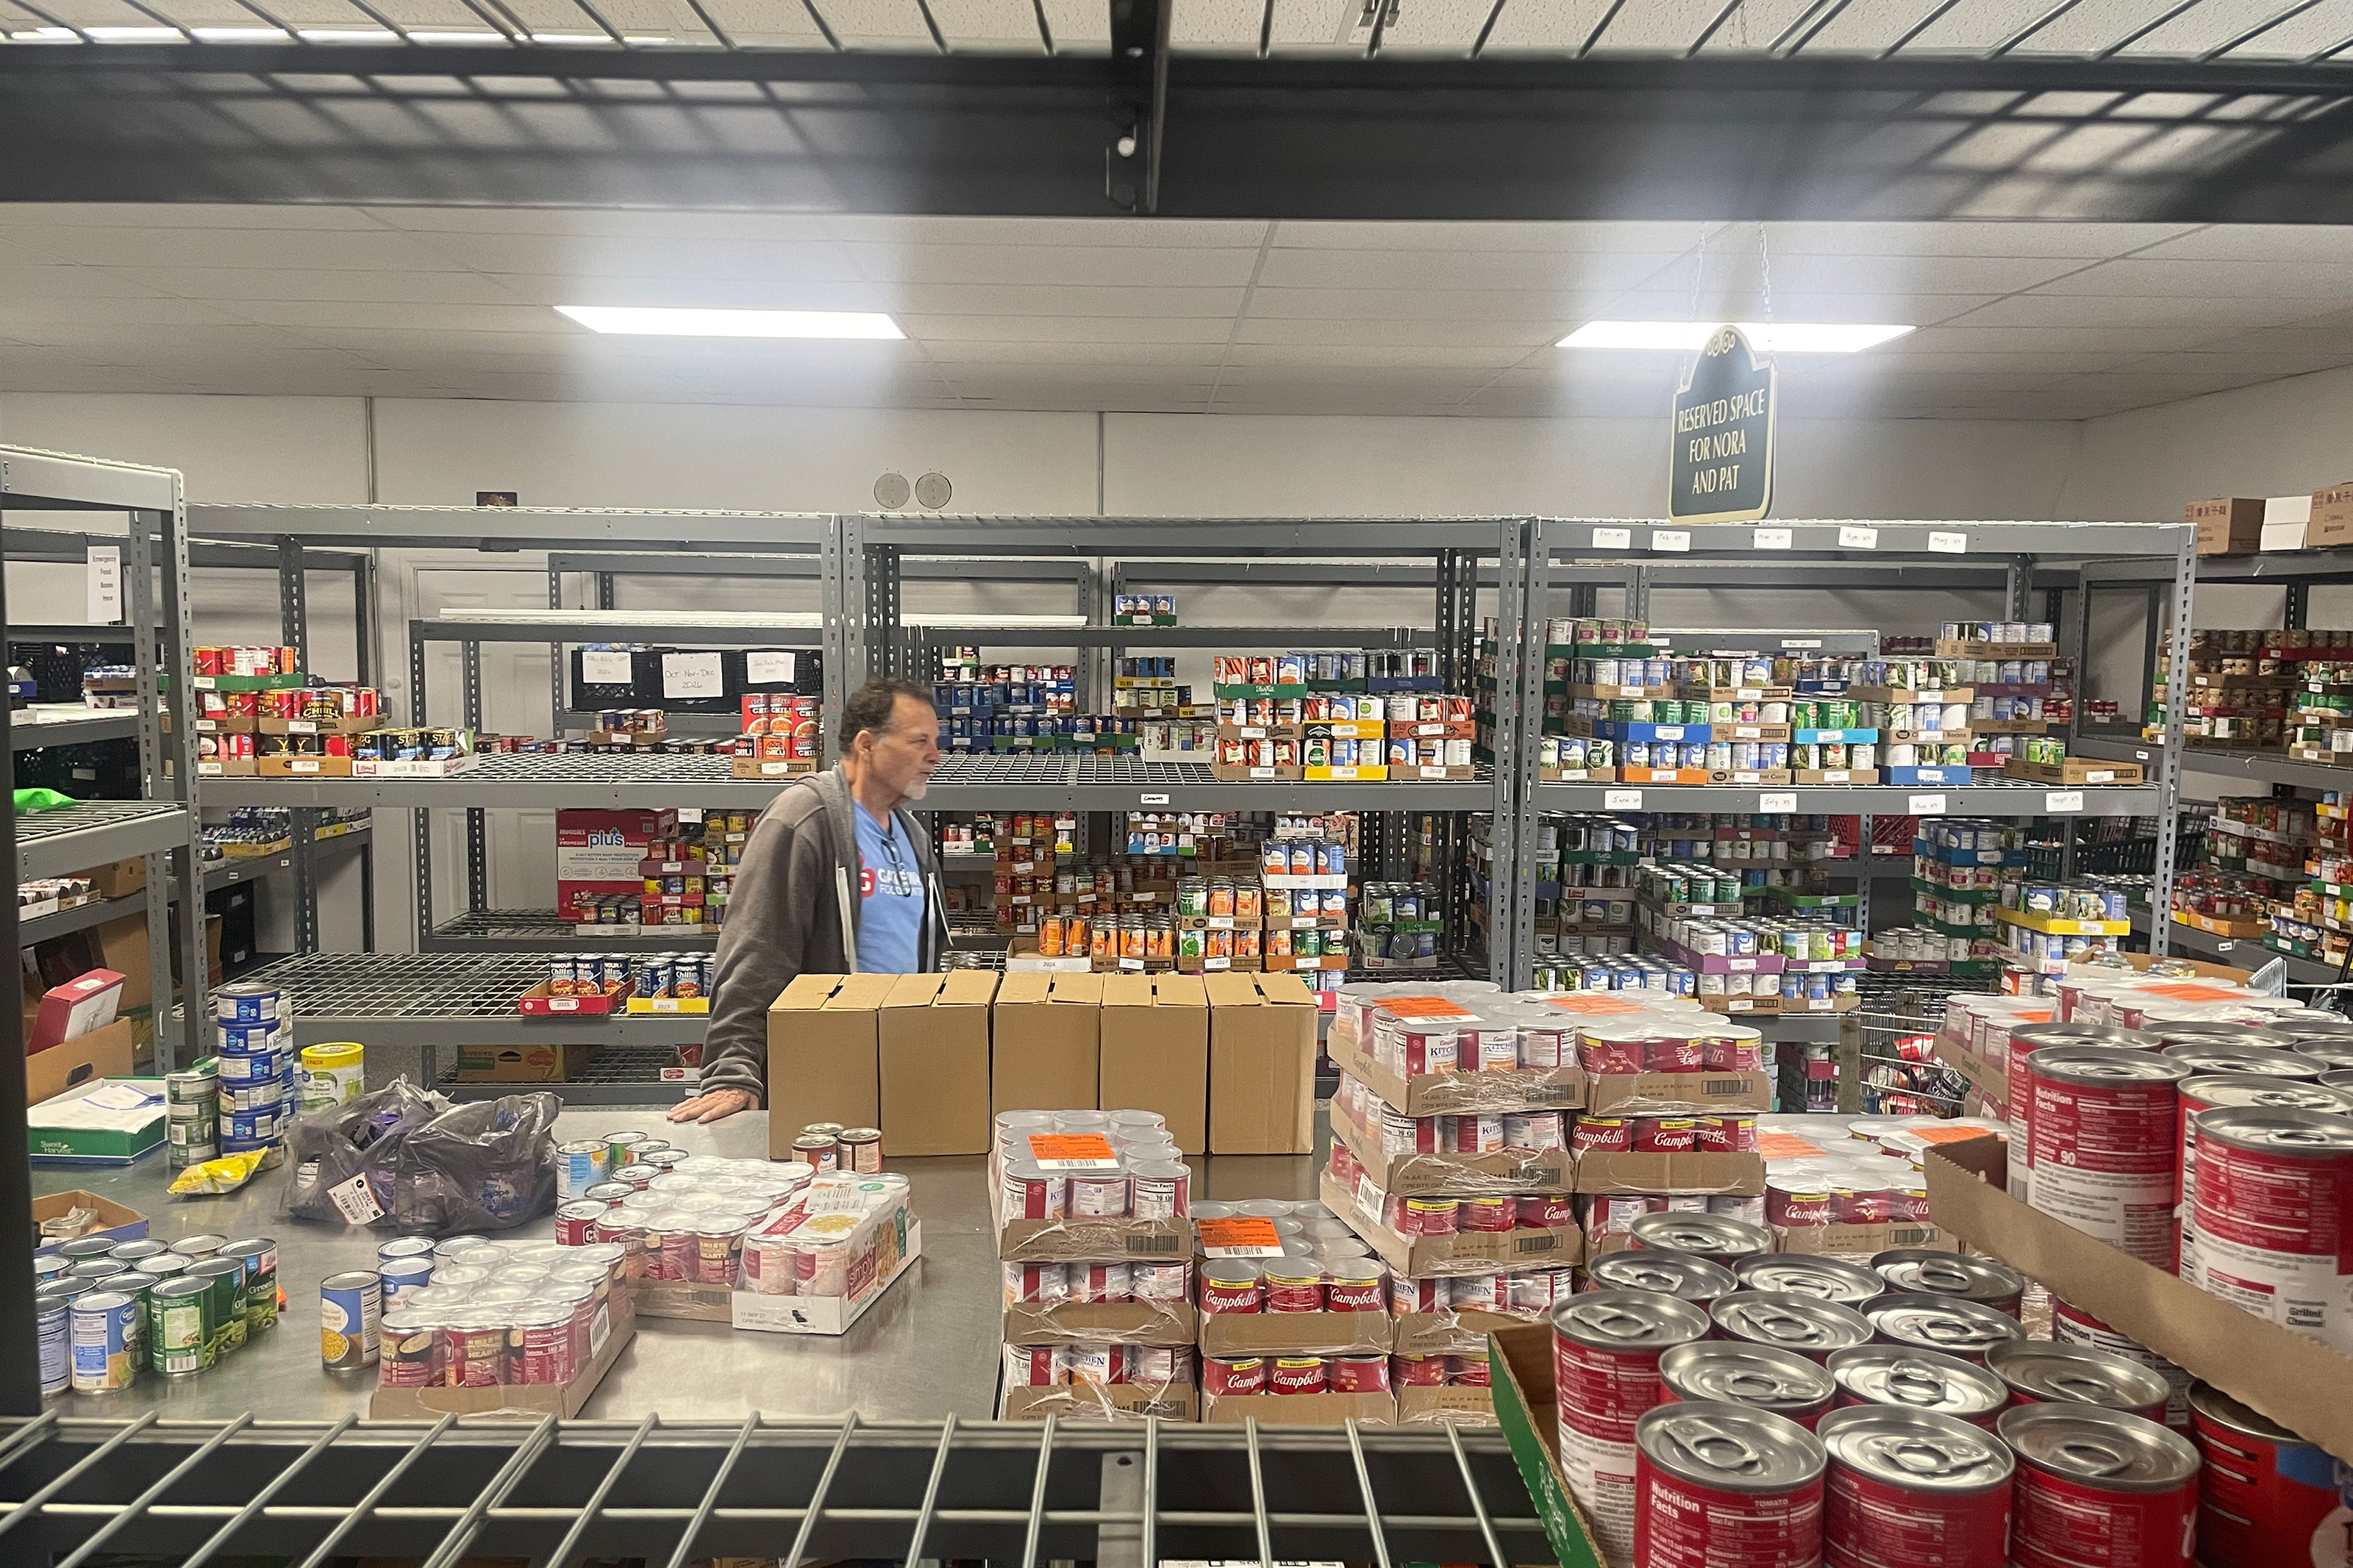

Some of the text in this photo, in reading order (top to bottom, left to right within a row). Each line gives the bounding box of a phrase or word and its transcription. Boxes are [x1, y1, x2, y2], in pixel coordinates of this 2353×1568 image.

[1677, 389, 1765, 434] RESERVED SPACE
[1689, 429, 1746, 462] FOR NORA
[1692, 465, 1740, 495] AND PAT
[1945, 731, 1967, 739] Beans
[2035, 1087, 2072, 1105] Nutrition
[2035, 1097, 2057, 1112] Facts
[40, 1140, 63, 1148] Sweet
[1572, 1125, 1624, 1144] Campbell's
[2061, 1150, 2077, 1165] 90
[849, 1253, 875, 1286] simply
[248, 1280, 275, 1294] Green
[1329, 1286, 1381, 1306] Campbell's
[1205, 1288, 1256, 1309] Campbell's
[1586, 1350, 1615, 1362] TOMATO
[1272, 1368, 1323, 1389] Campbell's
[1651, 1494, 1679, 1519] Facts
[1652, 1481, 1700, 1513] Nutrition
[1754, 1498, 1788, 1506] TOMATO
